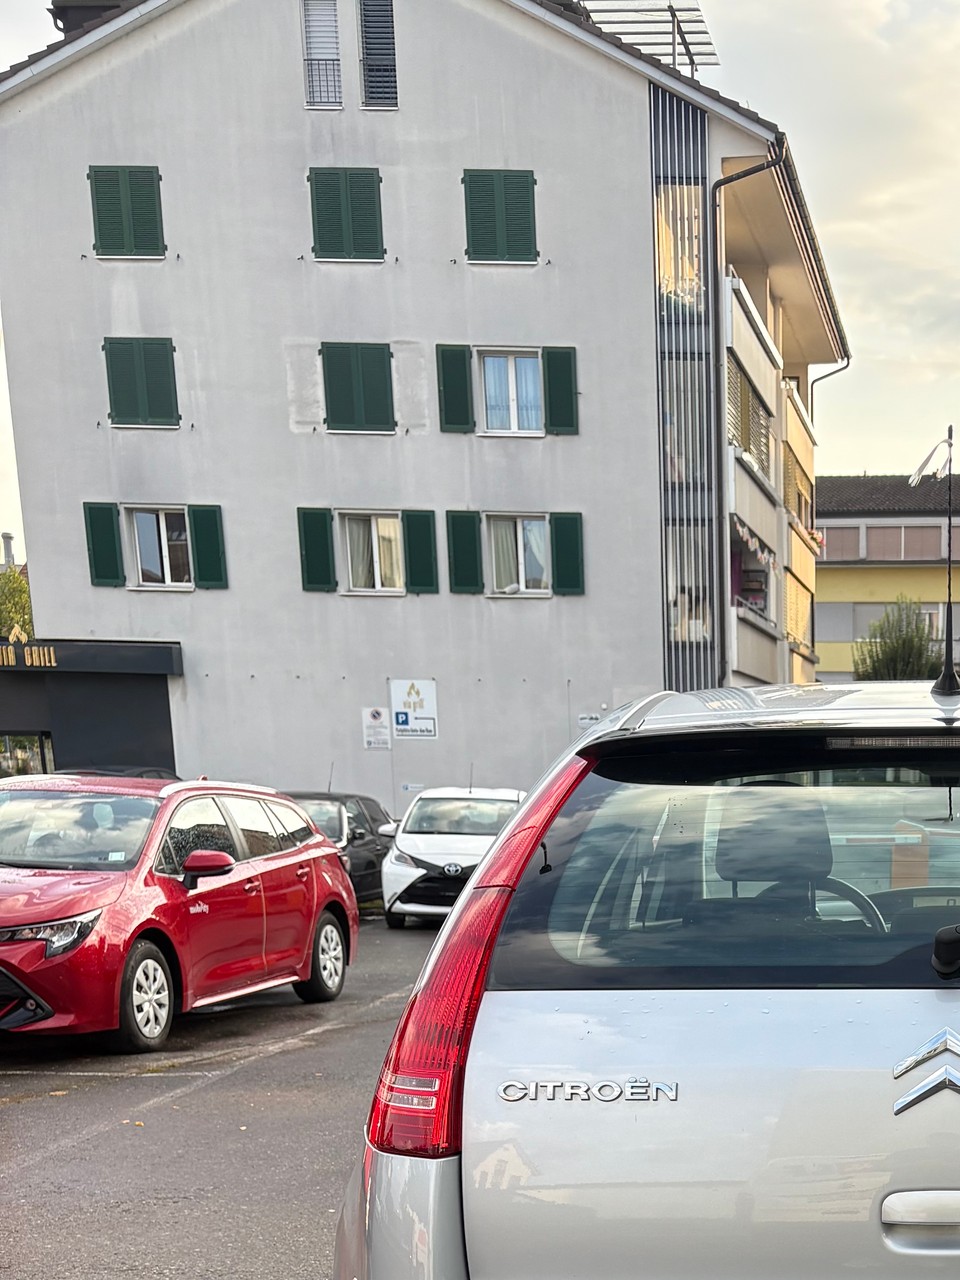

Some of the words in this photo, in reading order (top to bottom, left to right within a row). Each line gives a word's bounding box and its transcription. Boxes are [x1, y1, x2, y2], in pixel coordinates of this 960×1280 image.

[0, 645, 17, 667] IA
[24, 646, 58, 667] GRILL
[496, 1077, 679, 1102] CITROËN
